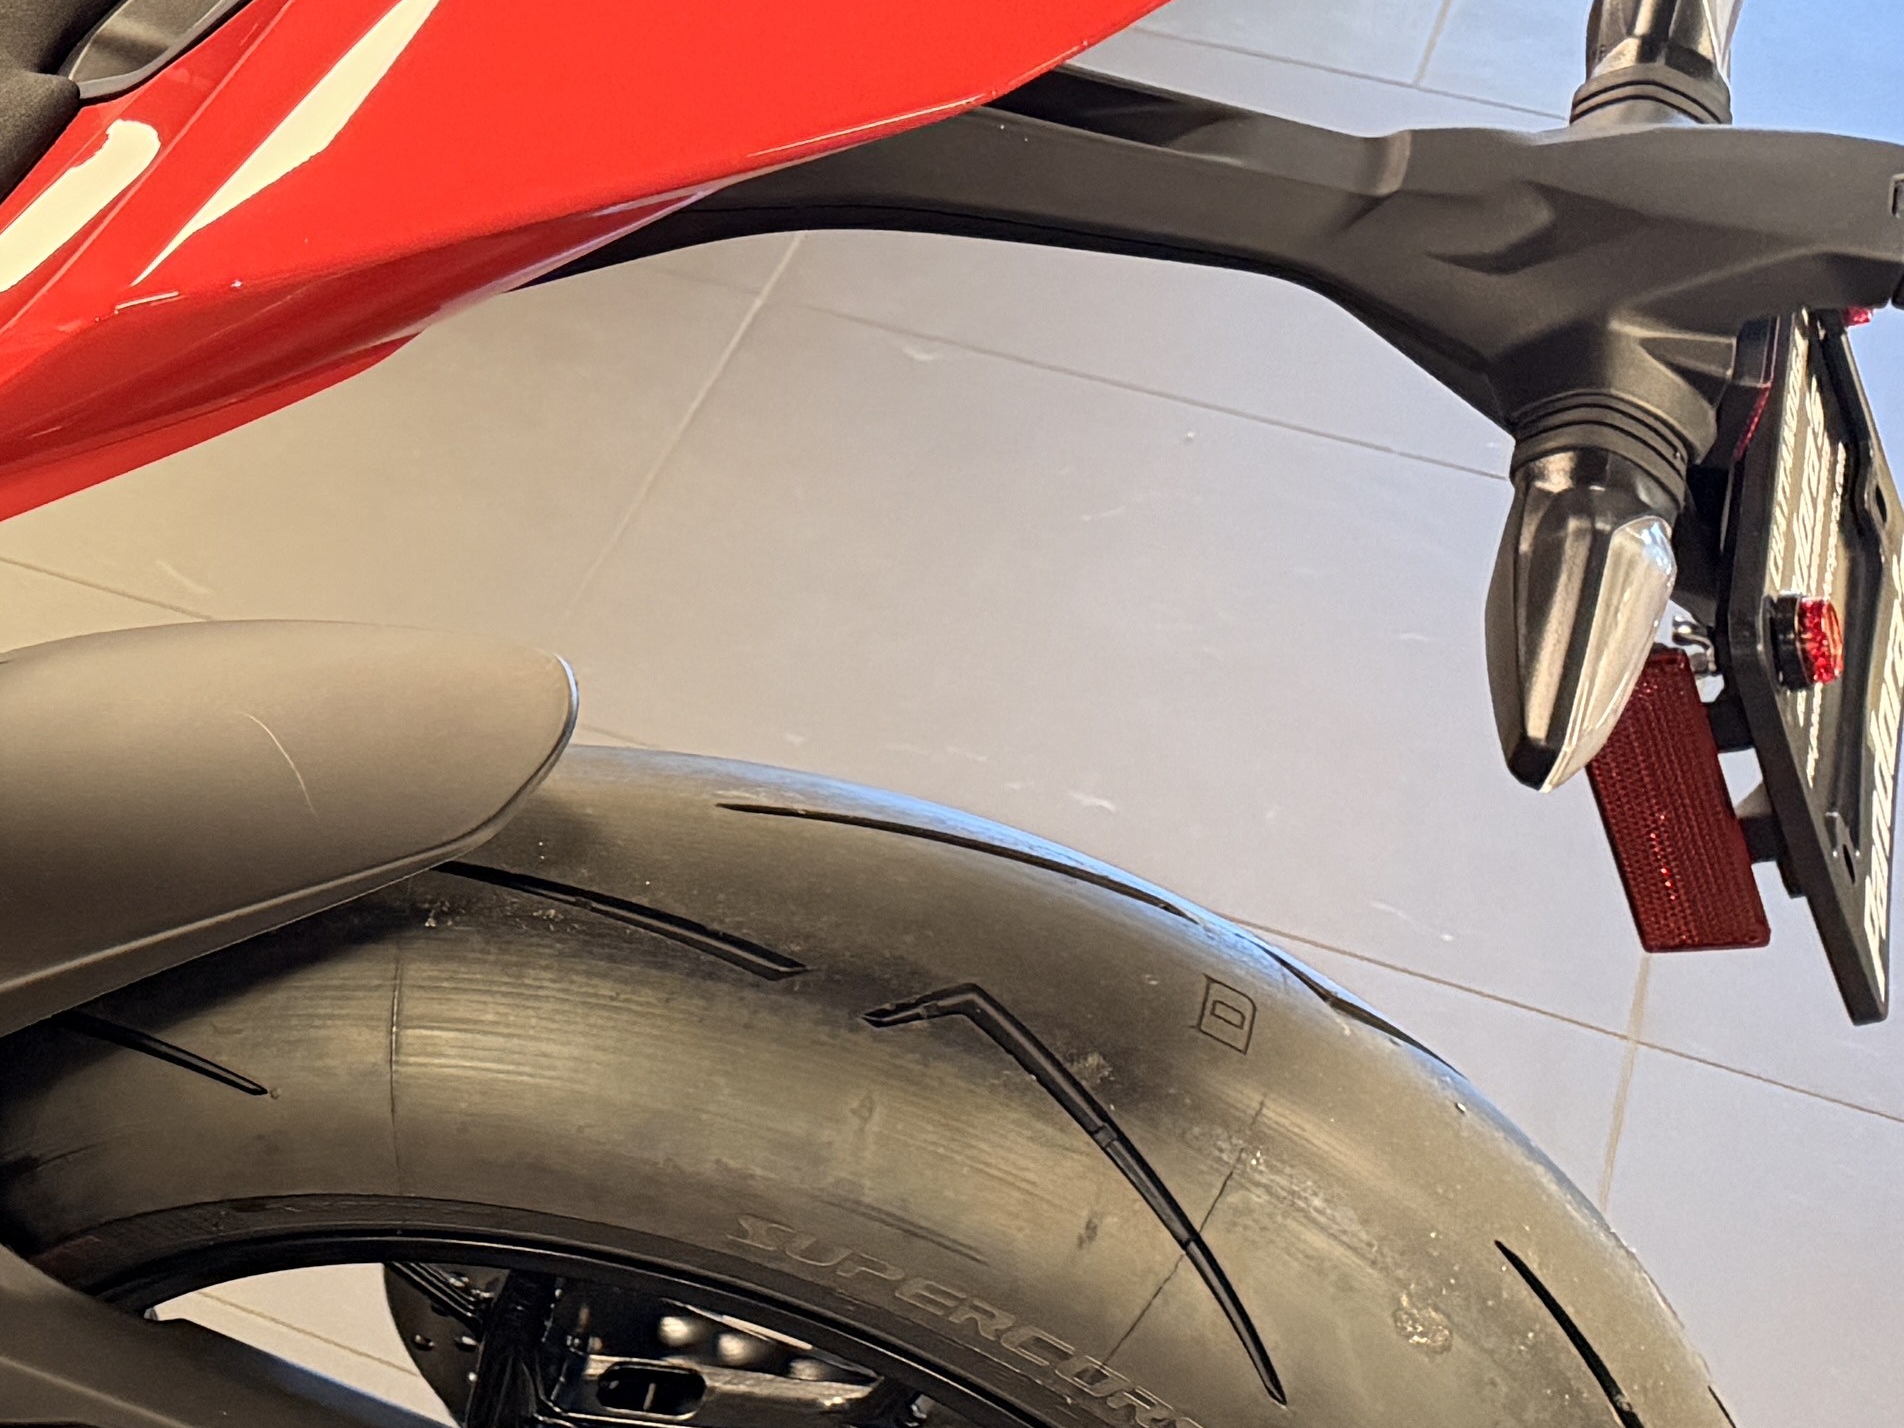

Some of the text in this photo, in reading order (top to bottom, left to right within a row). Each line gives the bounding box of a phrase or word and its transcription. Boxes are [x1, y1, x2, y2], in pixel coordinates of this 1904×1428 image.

[1770, 326, 1809, 594] CHATTANOOGA
[1792, 374, 1824, 594] dora's
[1864, 532, 1904, 1002] Pandora'
